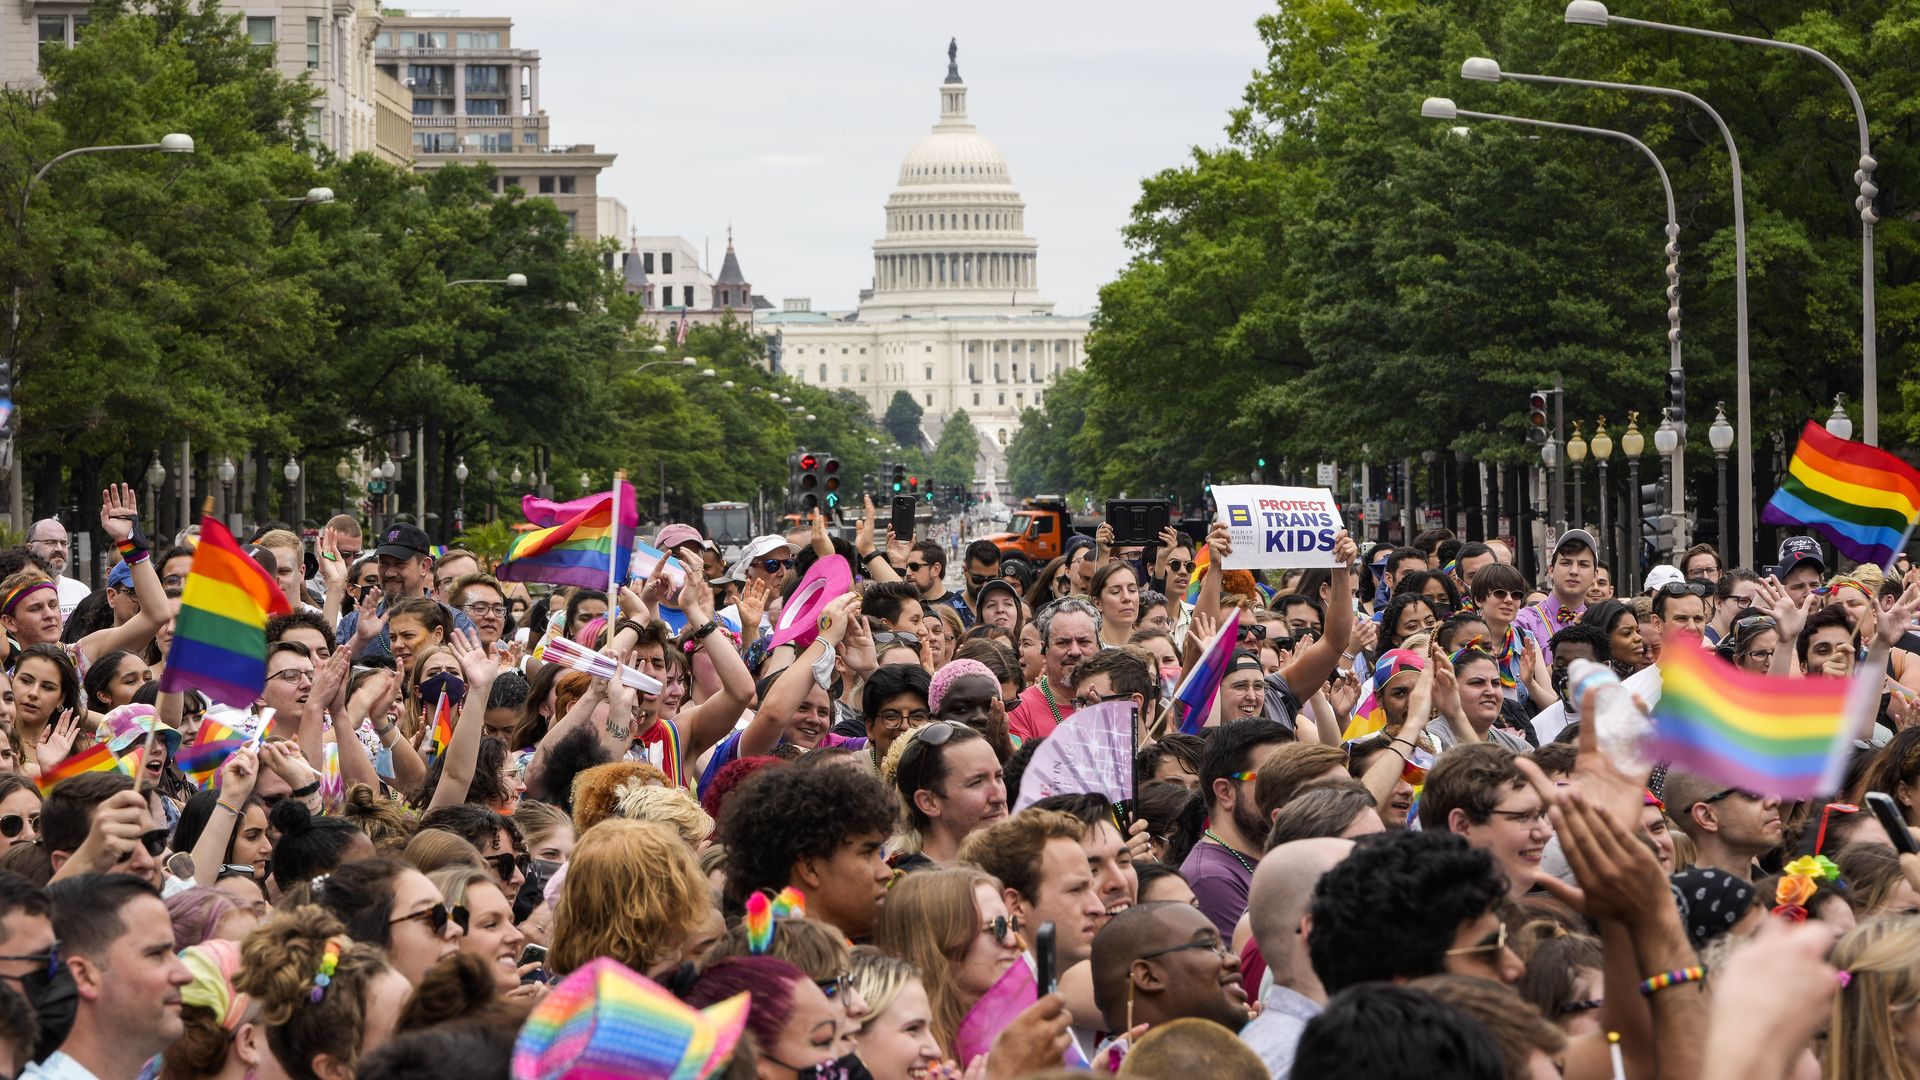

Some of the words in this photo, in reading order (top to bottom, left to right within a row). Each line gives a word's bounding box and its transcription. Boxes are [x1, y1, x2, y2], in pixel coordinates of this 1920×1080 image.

[1259, 499, 1326, 512] PROTECT
[1262, 512, 1333, 527] TRANS
[1266, 529, 1336, 552] KIDS
